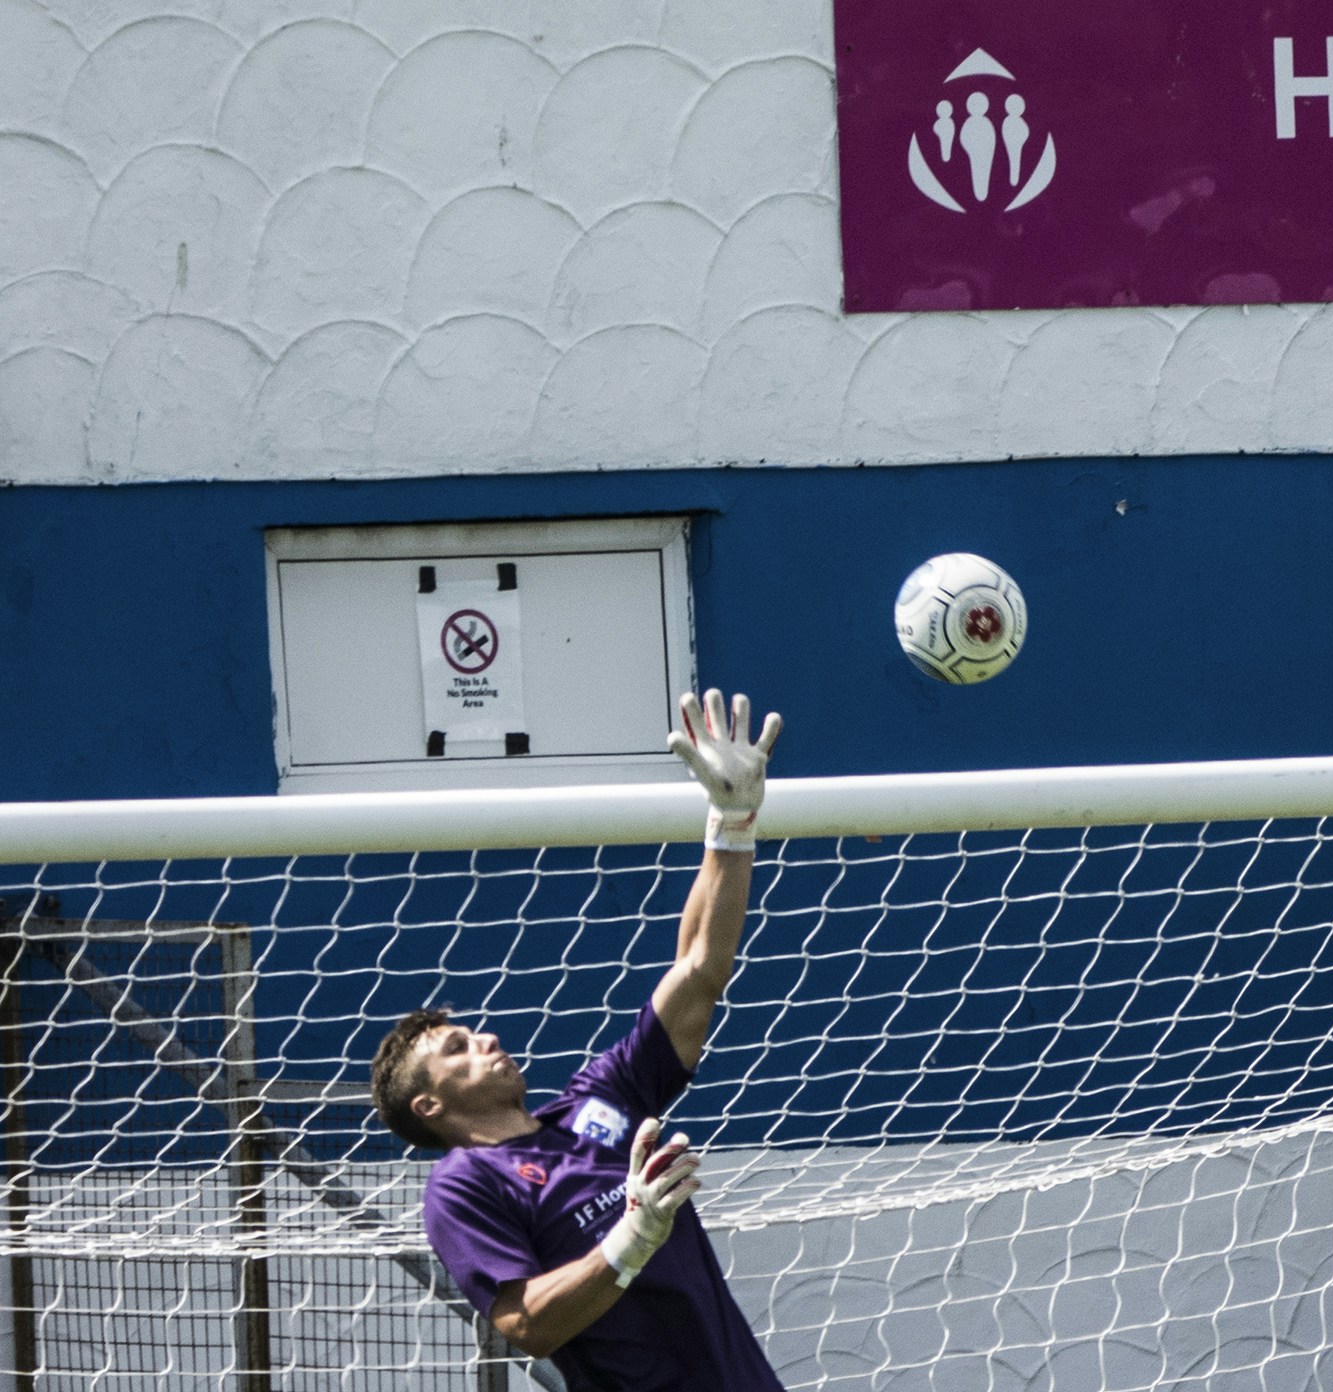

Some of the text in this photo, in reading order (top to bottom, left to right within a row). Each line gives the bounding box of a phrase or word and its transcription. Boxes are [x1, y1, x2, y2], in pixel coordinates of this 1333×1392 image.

[453, 677, 489, 687] This Is A
[447, 688, 498, 698] No Smoking
[462, 699, 484, 708] Area
[574, 1212, 586, 1228] J
[582, 1203, 594, 1221] F
